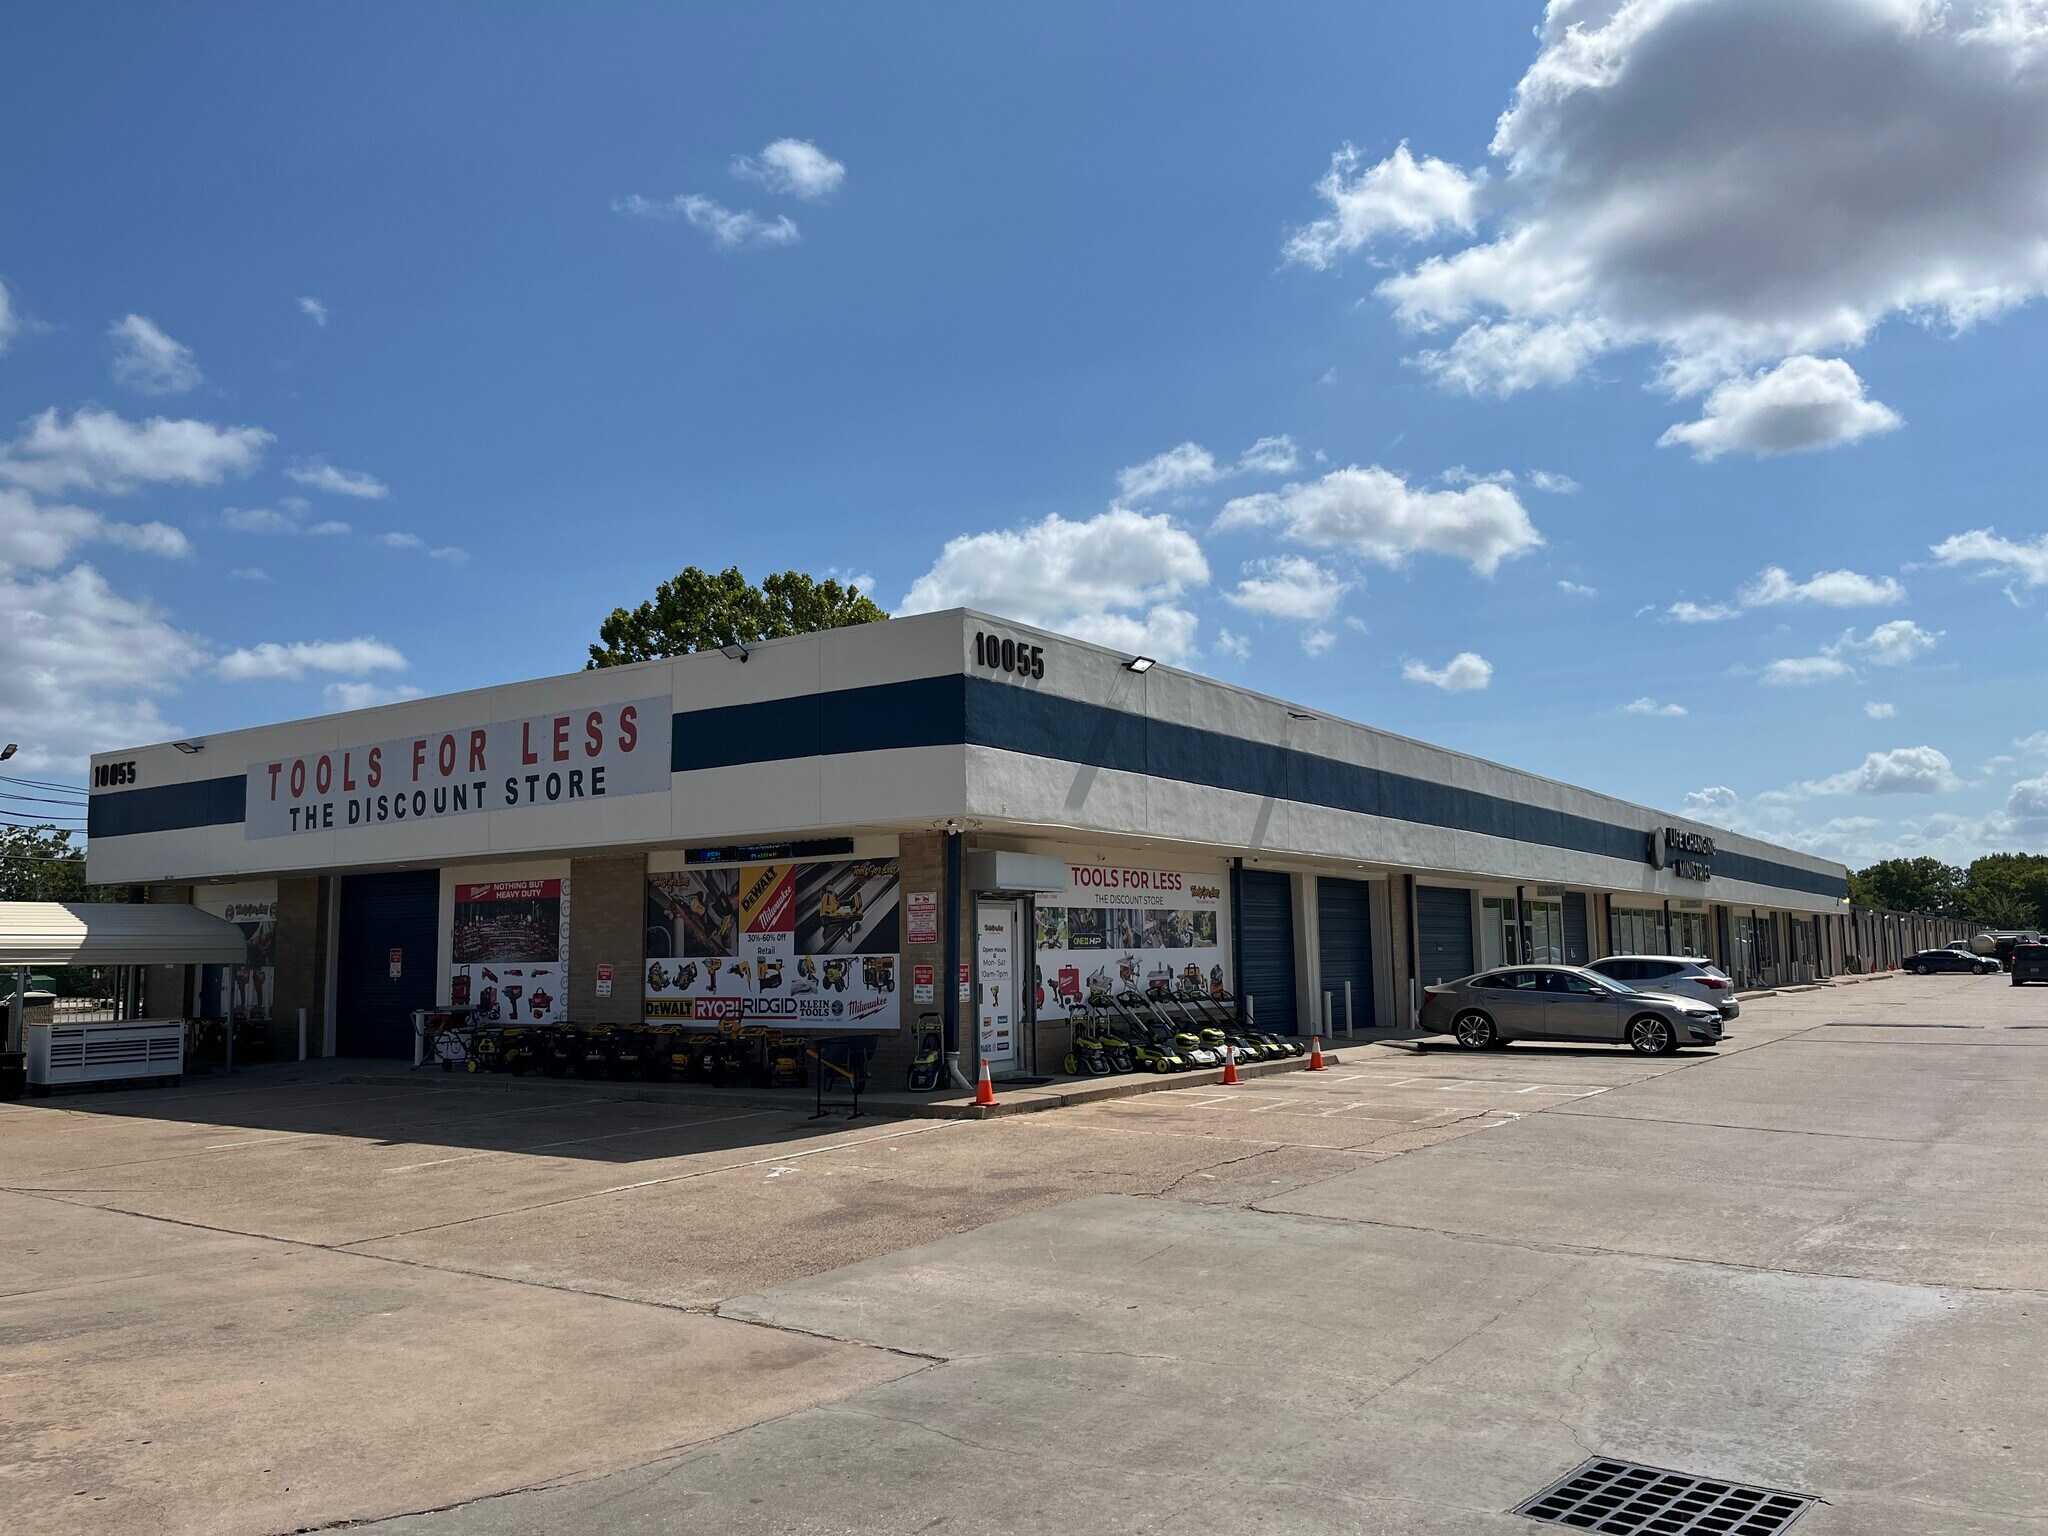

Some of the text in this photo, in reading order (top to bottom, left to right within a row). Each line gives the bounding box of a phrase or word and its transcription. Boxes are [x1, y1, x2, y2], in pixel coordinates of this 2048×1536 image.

[975, 631, 1045, 680] 10055
[267, 706, 638, 801] TOOLS FOR LESS
[94, 761, 136, 788] 10055
[289, 766, 606, 832] THE DISCOUNT STORE
[1071, 867, 1182, 890] TOOLS FOR LESS
[493, 881, 527, 891] NOTHING
[529, 880, 544, 888] BUT
[496, 889, 542, 899] HEAVY DUTY
[1095, 894, 1164, 905] THE DISCOUNT STORE
[758, 886, 792, 929] Milwaukee
[747, 933, 787, 942] 30%-60% Off
[1089, 937, 1102, 945] HP
[757, 946, 776, 955] Retail
[982, 946, 994, 954] Open
[997, 958, 1006, 966] Sat
[980, 969, 1009, 978] 10am-7pm
[645, 1002, 693, 1016] DEWALT
[696, 1000, 740, 1017] RYOBI
[742, 998, 798, 1014] RIDGID
[800, 1000, 830, 1008] KLEIN
[847, 996, 888, 1017] Milwaukee
[800, 1008, 830, 1017] TOOLS
